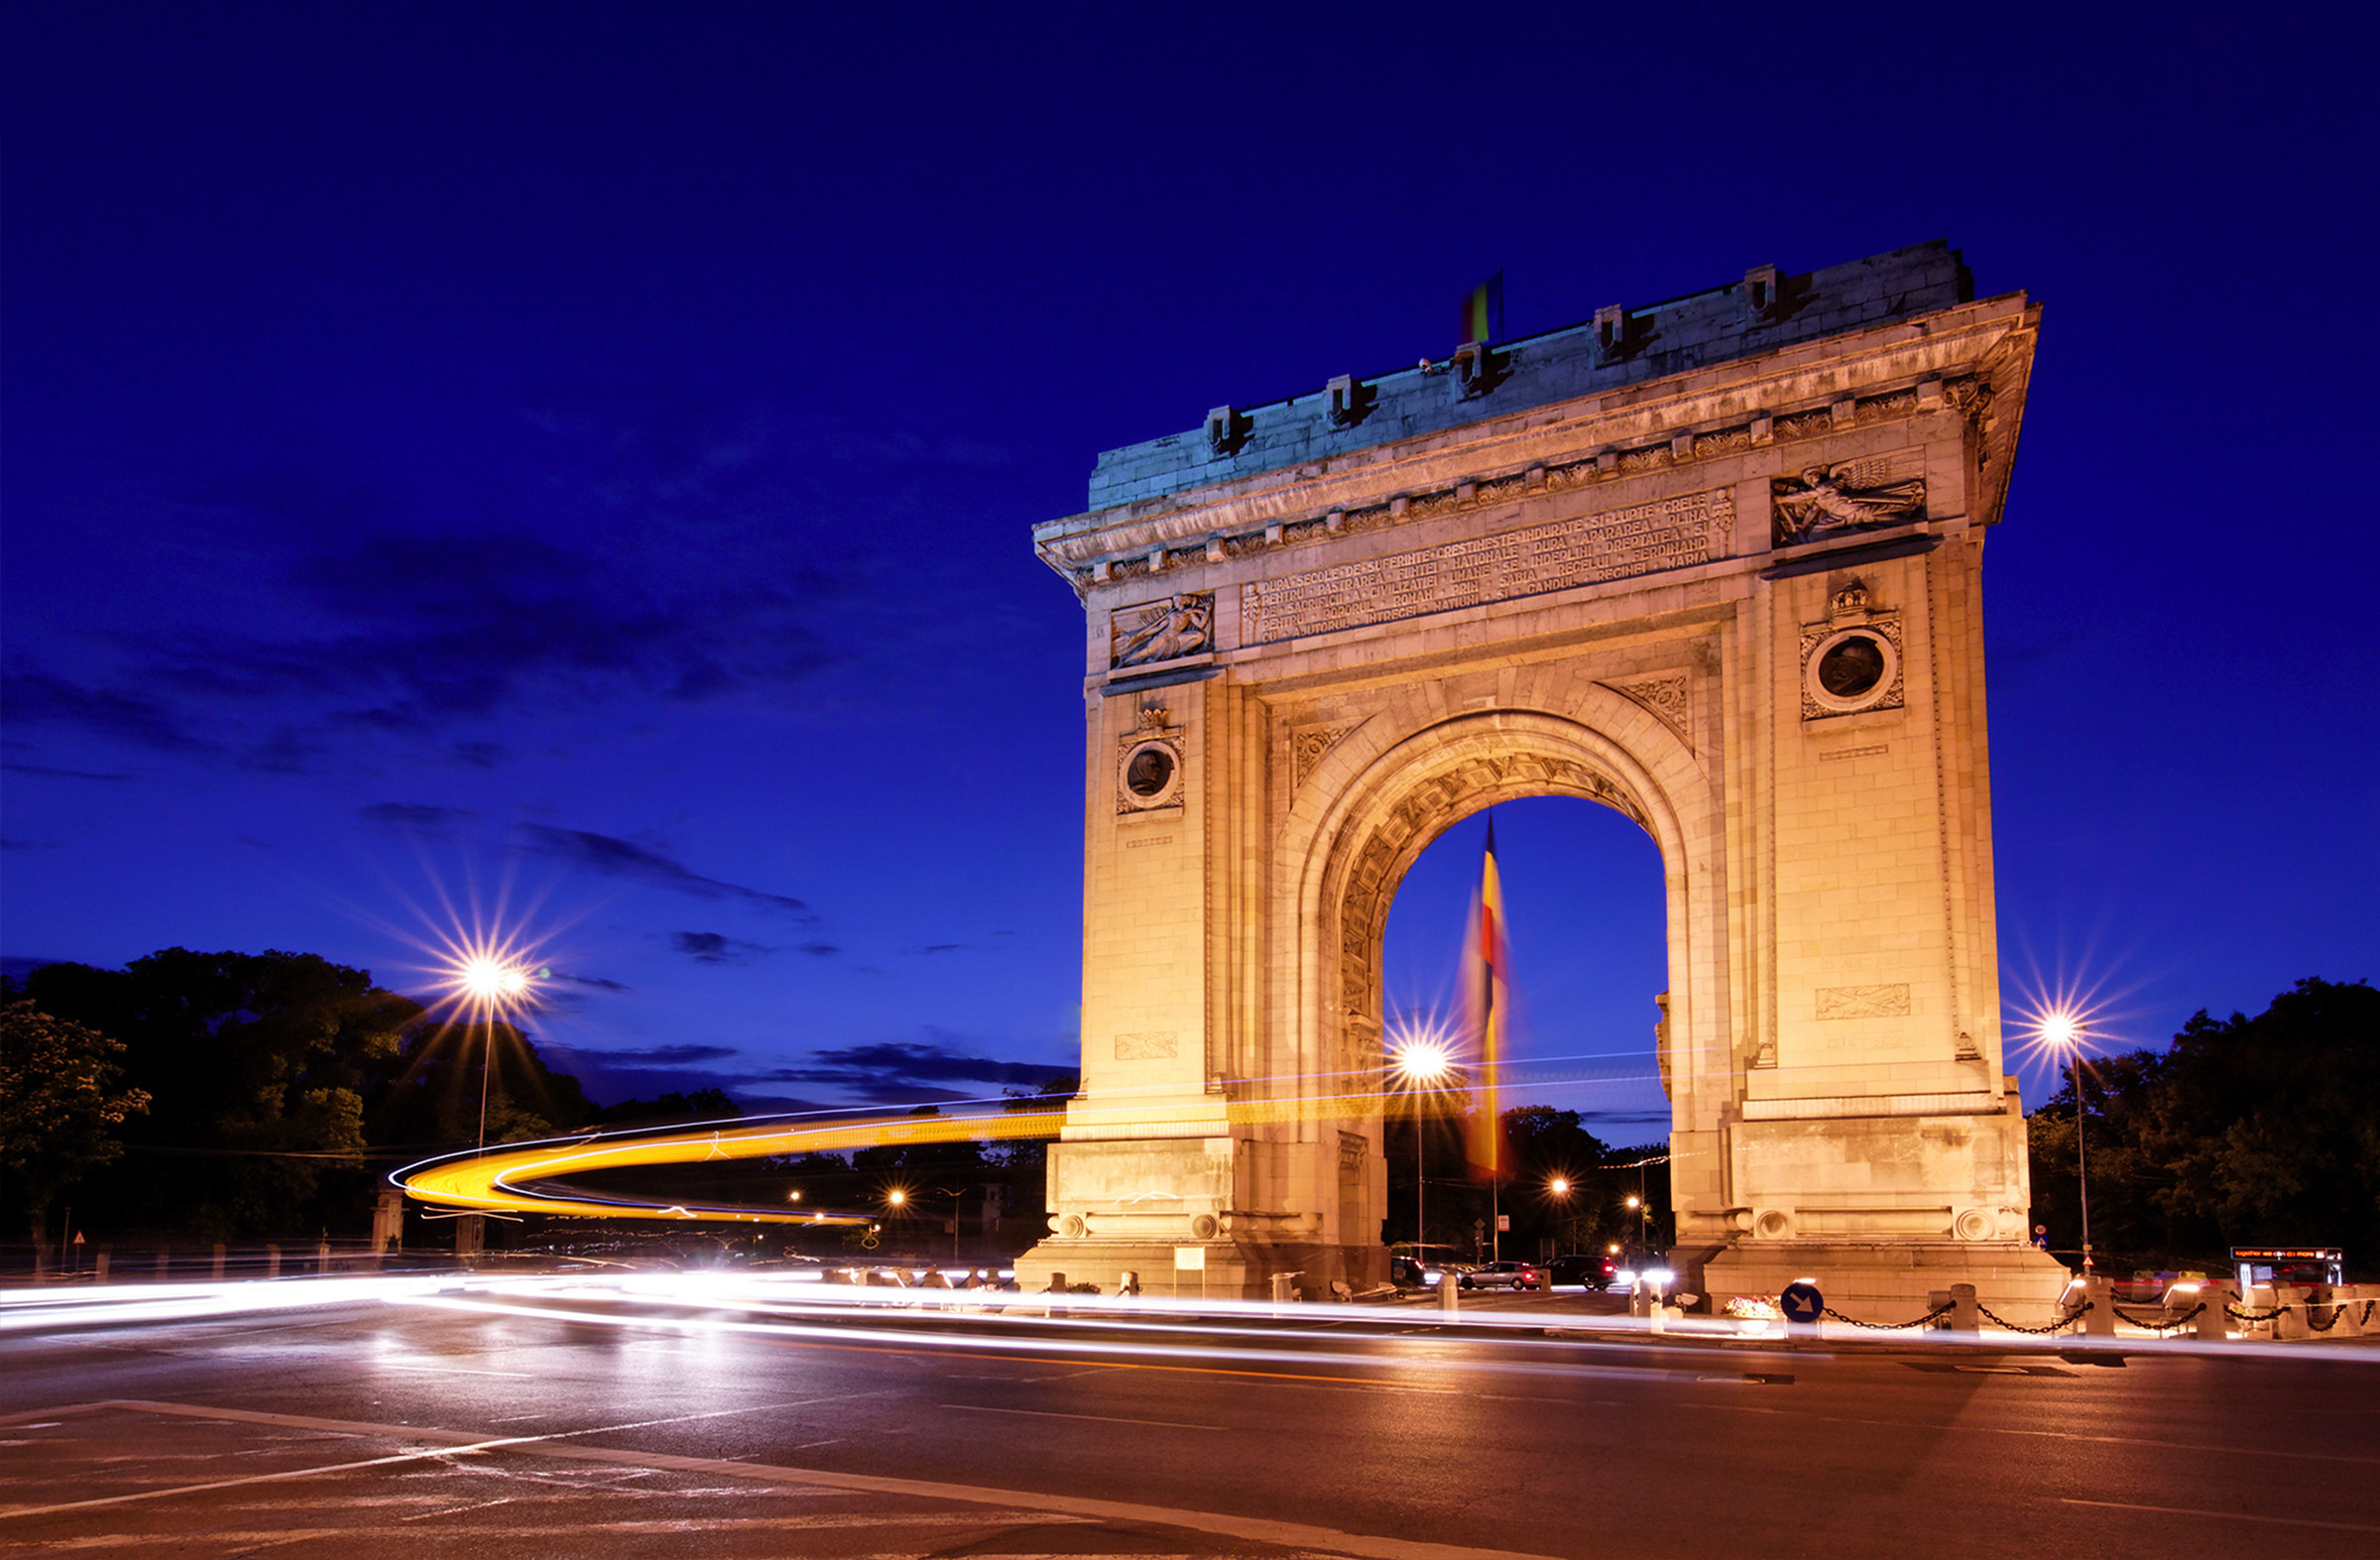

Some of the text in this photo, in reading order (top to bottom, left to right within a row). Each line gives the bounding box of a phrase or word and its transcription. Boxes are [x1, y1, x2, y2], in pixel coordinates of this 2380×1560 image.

[1262, 509, 1708, 605] PENTRU PASTRAREA FIINTEI NATIONALE DUPA APARAREA PLINA
[1262, 606, 1276, 618] DE
[1288, 593, 1344, 614] SACRIFICII
[1353, 590, 1362, 601] A
[1370, 575, 1438, 598] CIVILIZATIEI
[1451, 565, 1489, 583] UMANE
[1502, 557, 1518, 573] SE
[1531, 545, 1593, 567] INDEPLINI
[1606, 529, 1680, 553] DREPTATEA
[1262, 537, 1707, 630] PENTRU POPORUL ROMAN PRIN SABIA REGELUI FERDINAND
[1263, 578, 1290, 593] DUPA
[1297, 568, 1339, 586] SECOLE
[1346, 564, 1361, 576] DE
[1368, 549, 1430, 572] SUFERINTE
[1437, 533, 1515, 557] CRESTINESTE
[1523, 520, 1583, 541] INDURATE
[1612, 505, 1654, 523] LUPTE
[1663, 495, 1706, 513] GRELE
[1262, 630, 1278, 643] CU
[1292, 617, 1350, 638] AJUTORUL
[1366, 605, 1417, 624] INTREGEI
[1433, 594, 1480, 612] NATIUNI
[1527, 575, 1577, 594] GANDUL
[1597, 562, 1646, 582] REGINEI
[1666, 550, 1709, 569] MARIA
